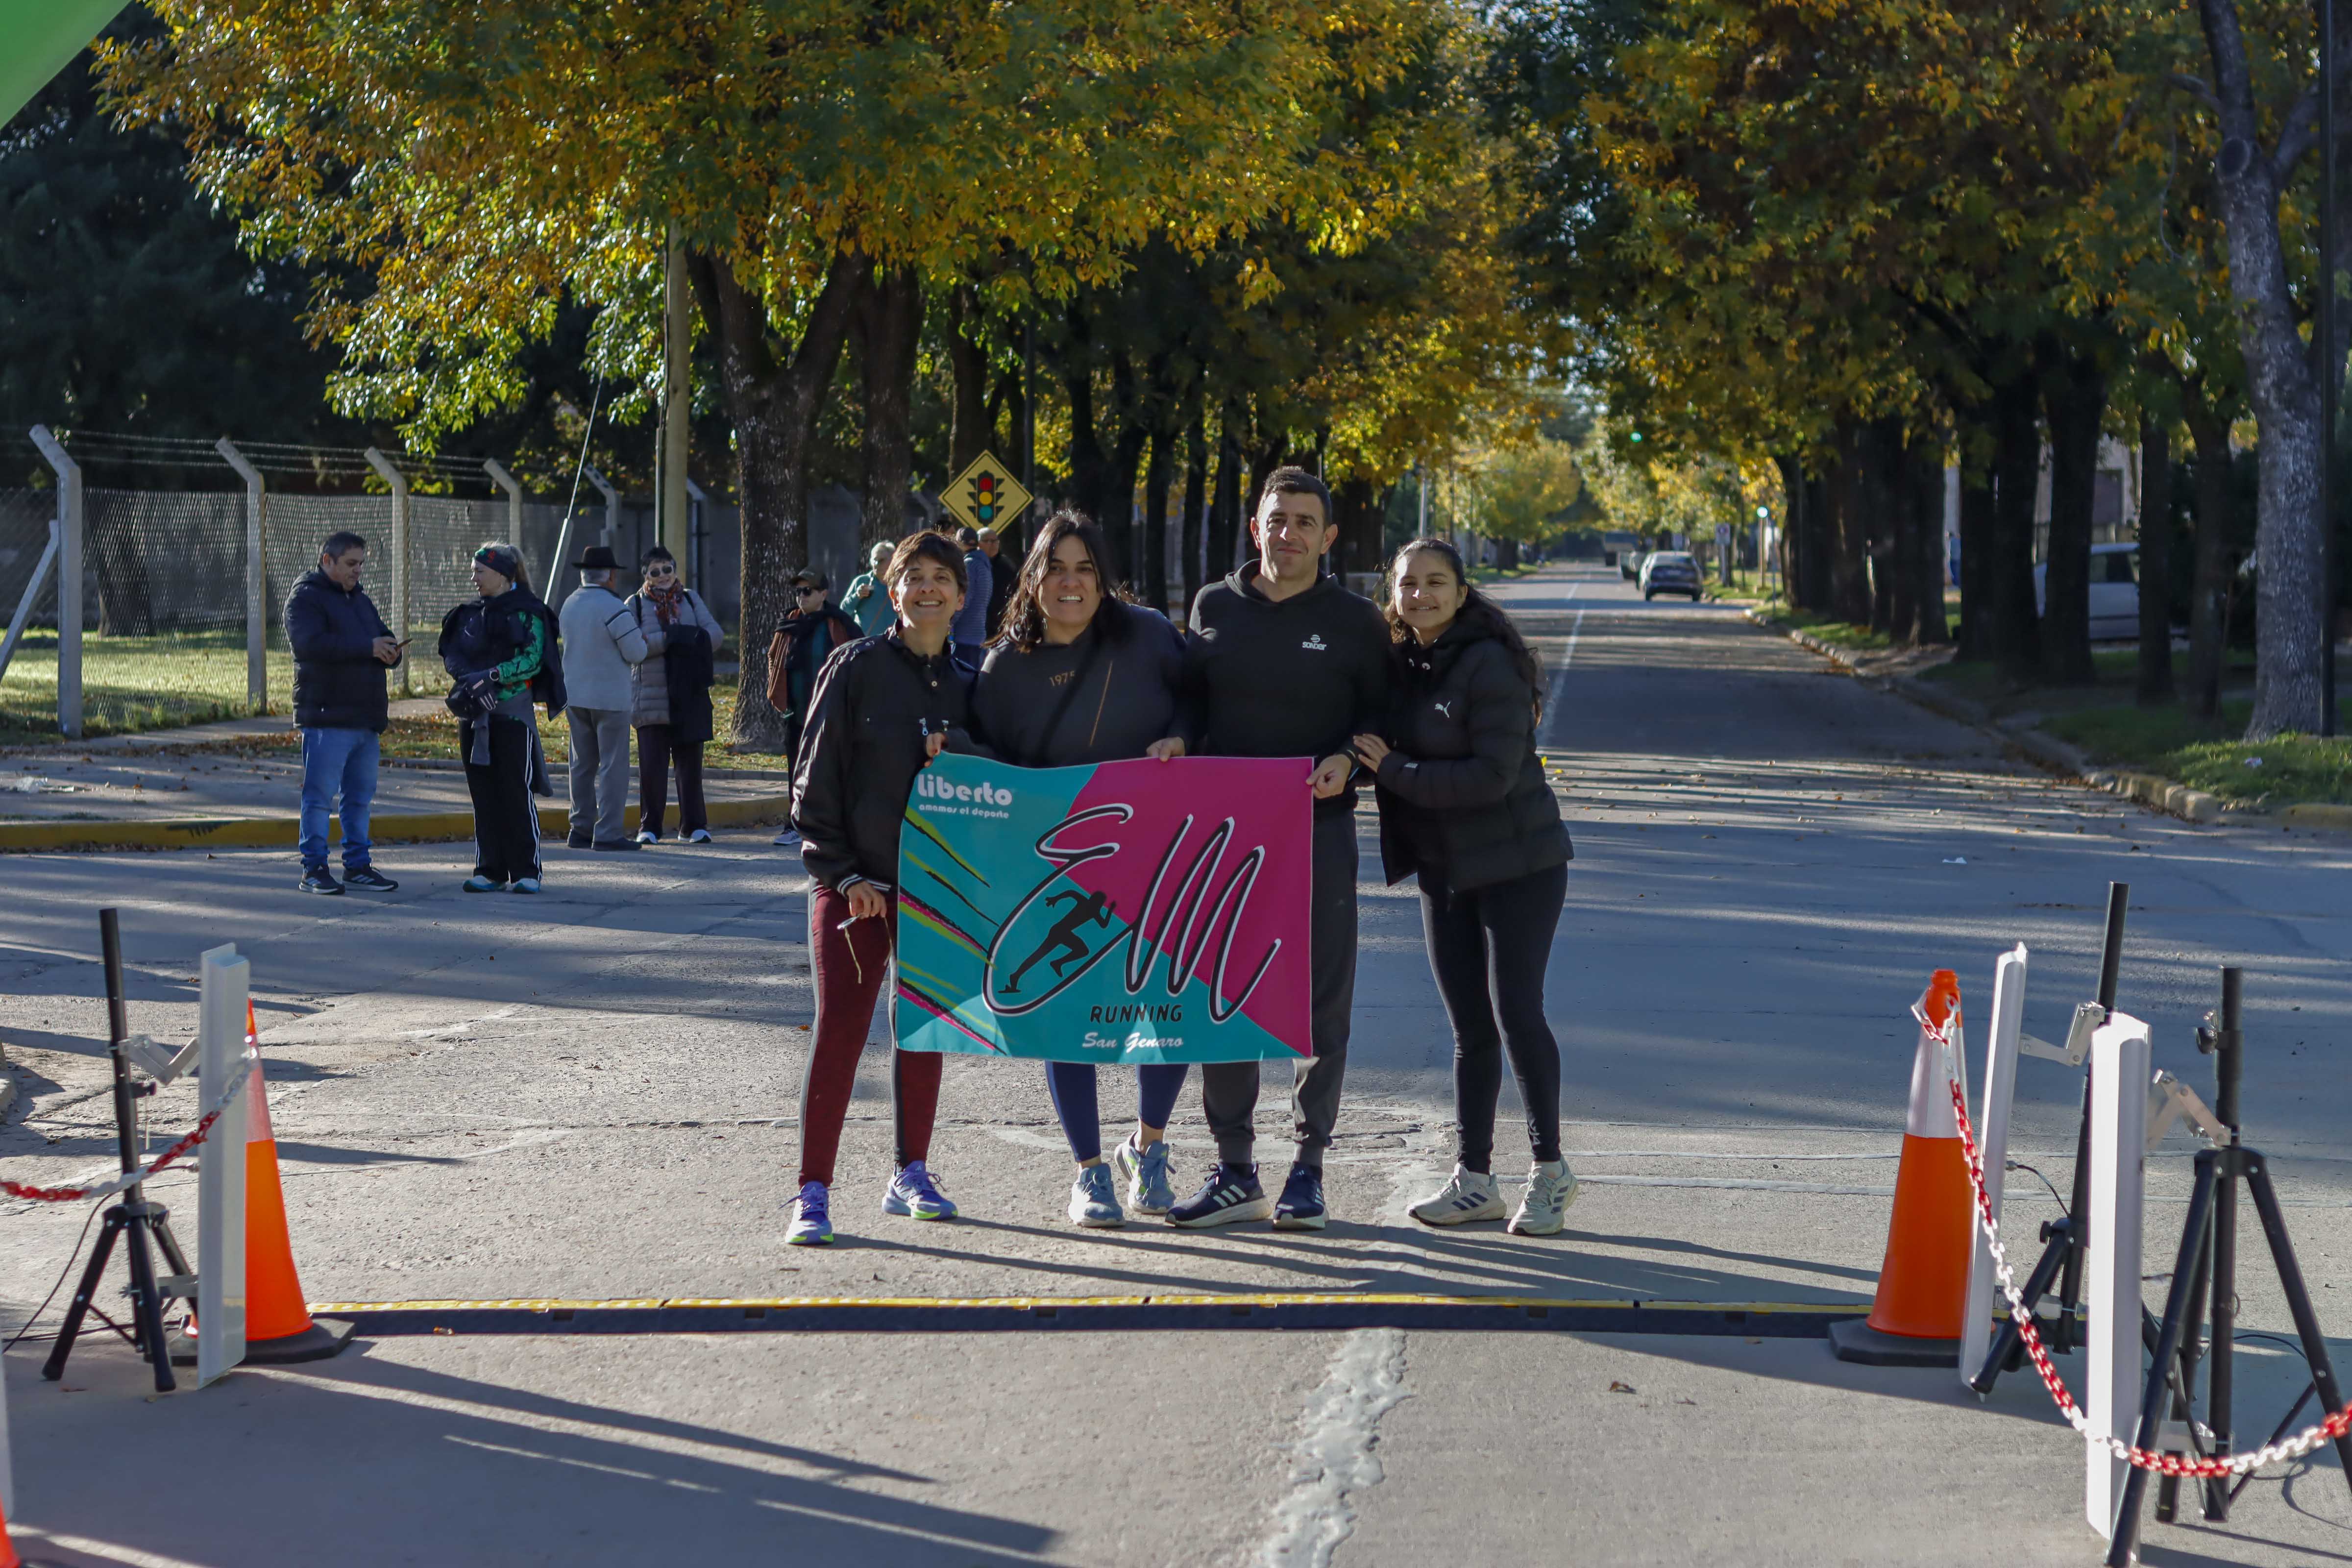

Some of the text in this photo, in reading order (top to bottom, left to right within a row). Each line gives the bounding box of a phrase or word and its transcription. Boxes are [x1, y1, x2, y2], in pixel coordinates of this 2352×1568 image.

[918, 804, 1009, 819] amamos el deporte
[1089, 1004, 1183, 1024] RUNNING
[1081, 1031, 1184, 1054] San Genaro
